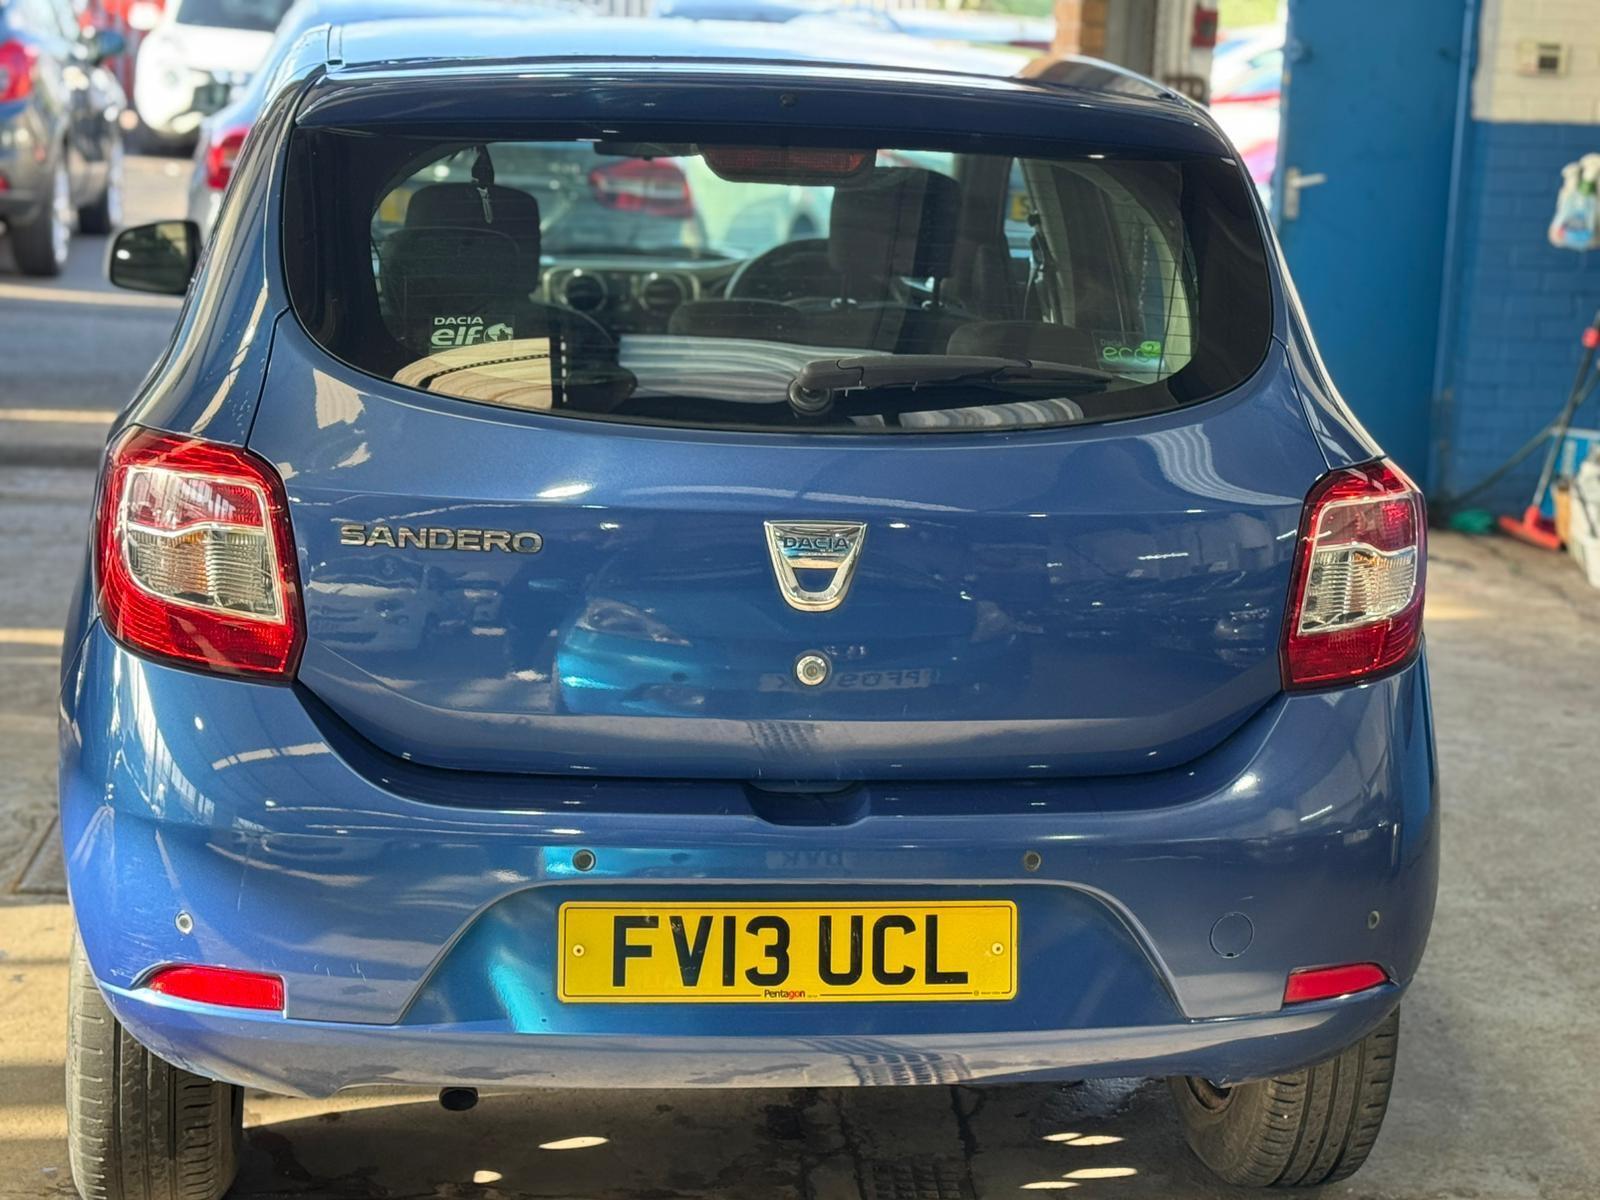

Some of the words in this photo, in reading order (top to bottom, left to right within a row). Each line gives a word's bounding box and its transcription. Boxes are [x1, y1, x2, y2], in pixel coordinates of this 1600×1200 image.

[434, 316, 484, 325] DACIA
[431, 326, 484, 346] elf
[340, 523, 544, 554] SANDERO
[782, 536, 849, 549] DACIA
[612, 914, 791, 988] FV13
[817, 913, 969, 987] UCL
[764, 989, 806, 1000] Pentagon
